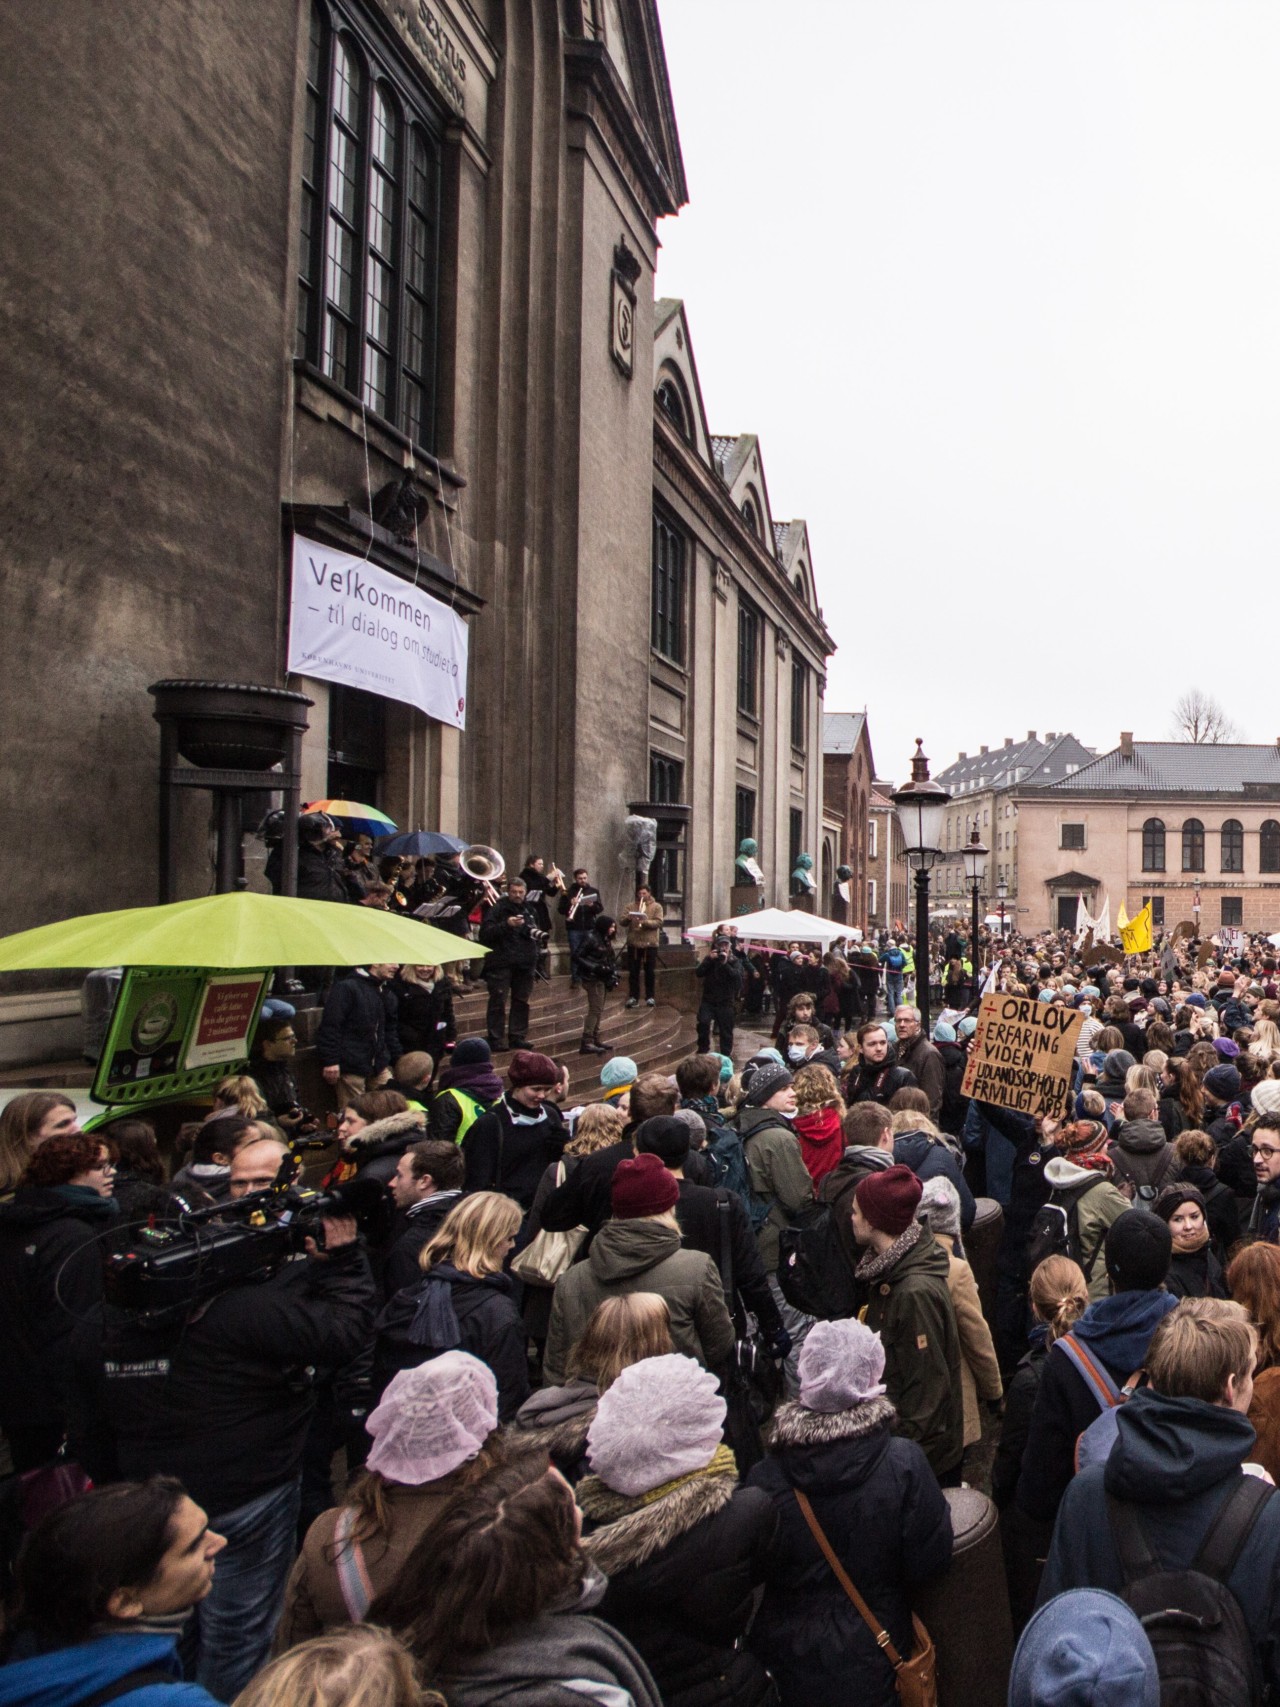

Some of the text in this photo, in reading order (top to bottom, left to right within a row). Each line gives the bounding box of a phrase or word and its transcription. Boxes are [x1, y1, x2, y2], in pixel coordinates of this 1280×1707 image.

[309, 557, 431, 632] Velkommen
[328, 604, 345, 626] til
[352, 612, 398, 650] dialog
[403, 635, 420, 656] om
[1002, 999, 1076, 1035] ORLOV
[985, 1042, 1034, 1068] VIDEN
[986, 1022, 1060, 1055] ERFARING
[972, 1079, 1035, 1112] FRIVILLIGT
[976, 1062, 1067, 1100] UDLANDSOPHOLD
